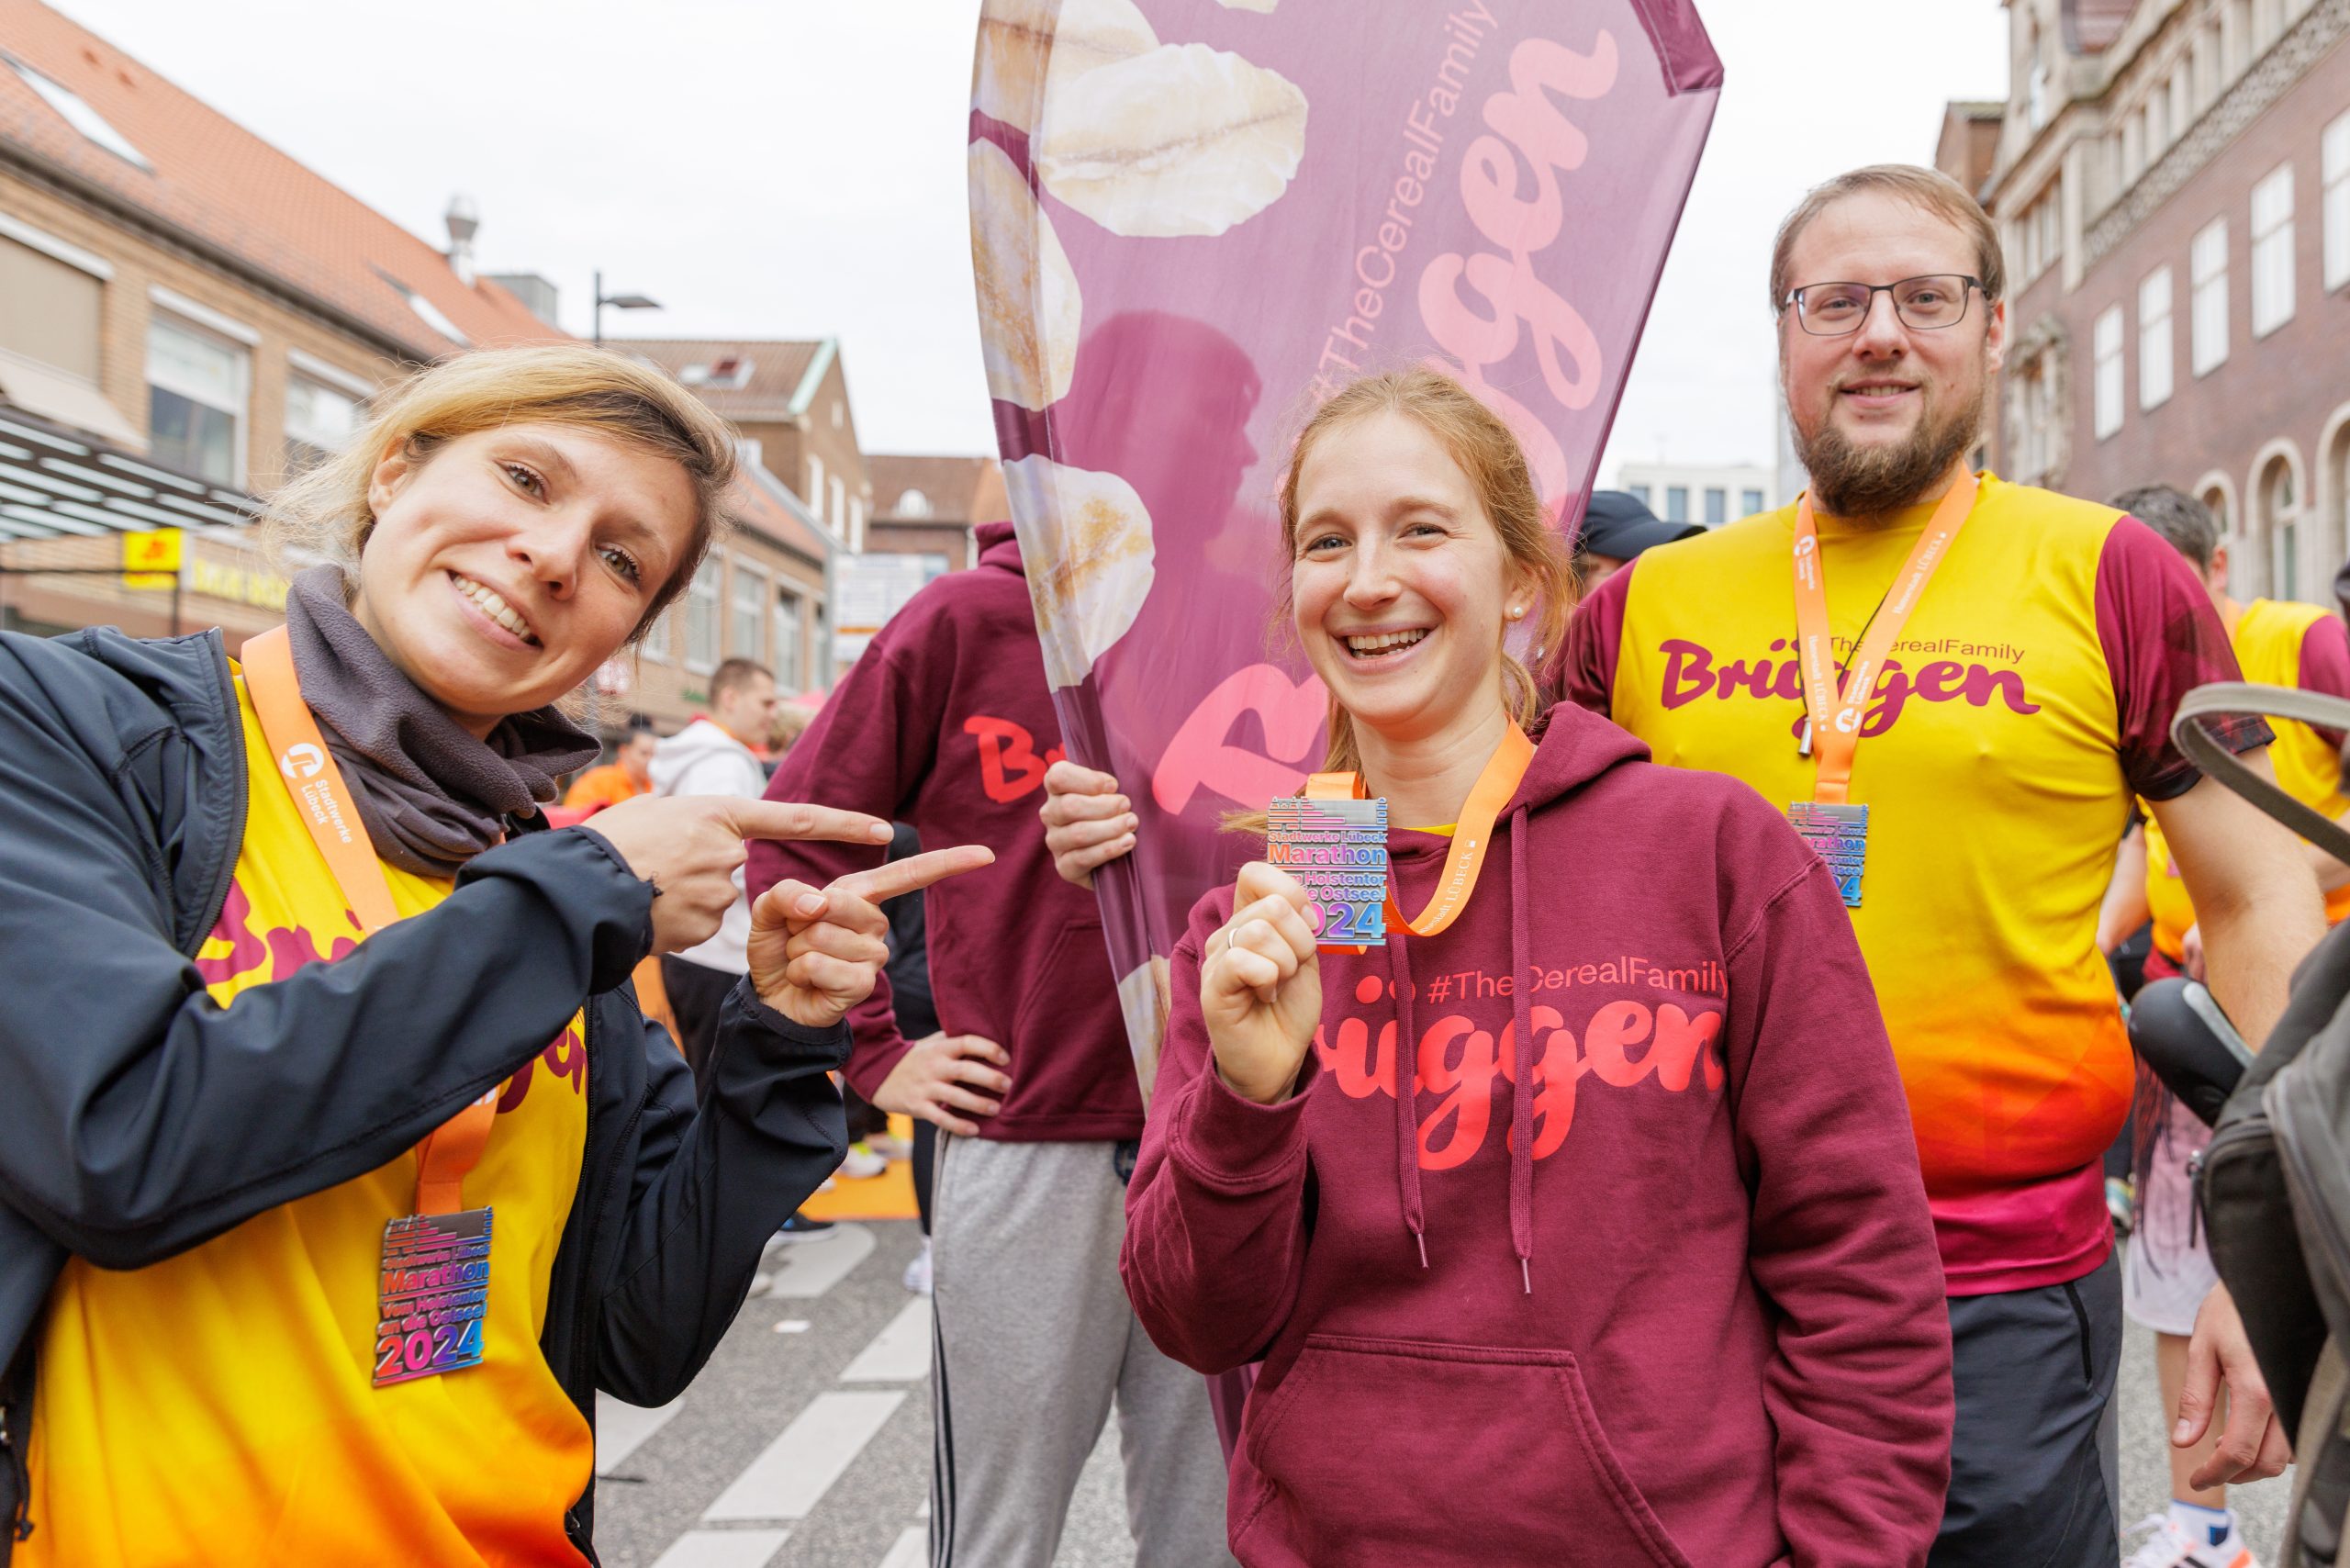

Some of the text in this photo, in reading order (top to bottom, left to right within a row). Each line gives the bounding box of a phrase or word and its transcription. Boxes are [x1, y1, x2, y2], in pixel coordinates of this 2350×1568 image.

[300, 784, 329, 825] Lübeck
[315, 778, 352, 844] Stadtwerke
[1268, 831, 1388, 844] Stadtwerke Lübeck
[1268, 843, 1388, 865] Marathon
[1800, 834, 1866, 850] rathon
[1304, 871, 1387, 886] Holstentor
[1446, 851, 1474, 902] LÜBECK
[1320, 886, 1387, 902] Ostsee!
[381, 1260, 490, 1294] Marathon
[376, 1300, 488, 1336] an die Ostsee!
[375, 1319, 485, 1379] 2024
